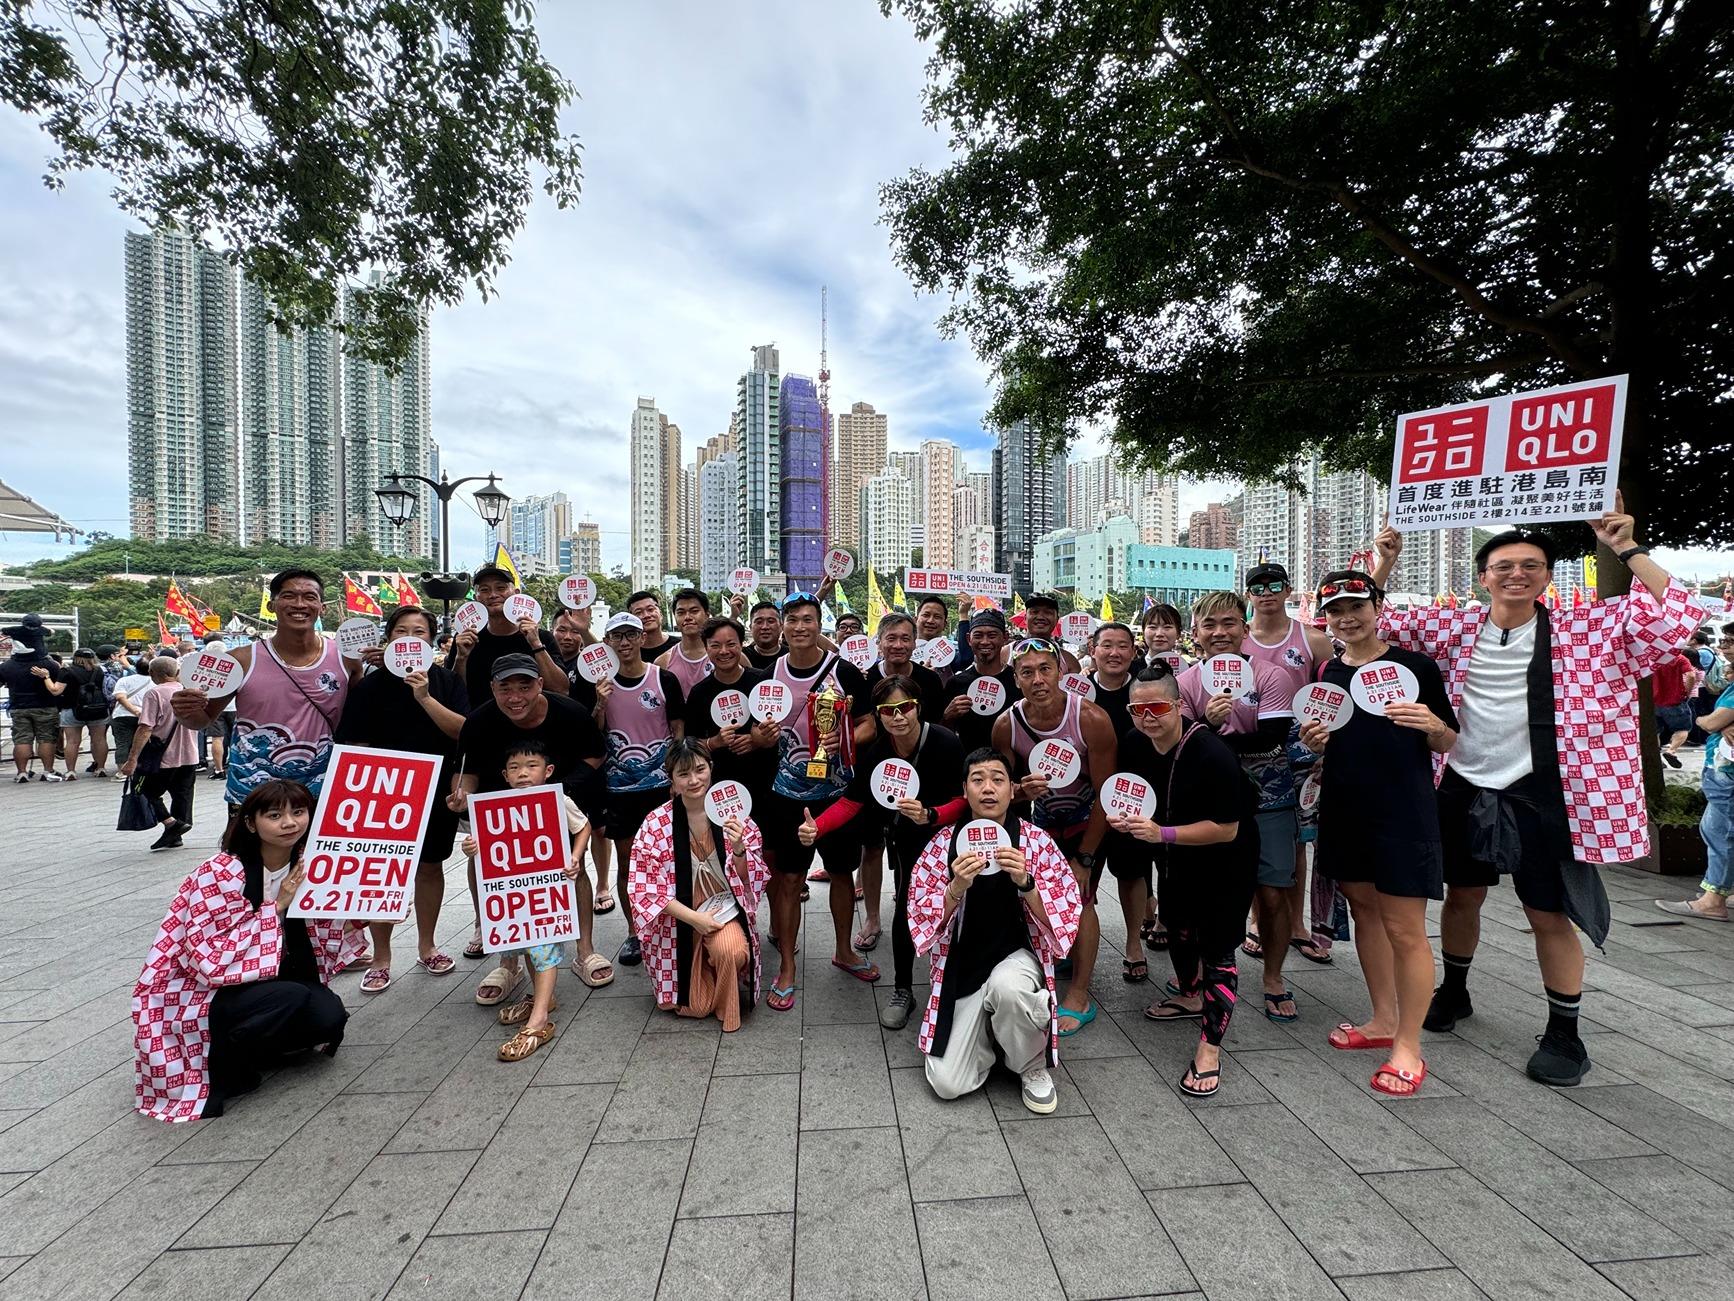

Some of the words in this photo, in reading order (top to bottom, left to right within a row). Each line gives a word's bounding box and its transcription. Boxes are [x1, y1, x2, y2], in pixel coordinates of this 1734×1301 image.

[1521, 398, 1593, 431] UNI
[1518, 429, 1596, 464] QLO
[1398, 466, 1607, 503] 首度進駐港島南
[1396, 502, 1447, 515] LifeWear
[1451, 496, 1504, 510] 伴隨社區
[1511, 489, 1604, 505] 凝聚美好生活
[1395, 516, 1413, 524] THE
[1418, 512, 1476, 523] SOUTHSIDE
[1482, 502, 1603, 519] 2樓214至221號舖
[829, 564, 846, 573] OPEN
[967, 575, 1007, 584] SOUTHSIDE
[590, 662, 613, 676] OPEN
[191, 674, 226, 688] OPEN
[974, 696, 996, 707] OPEN
[1368, 689, 1406, 704] OPEN
[721, 711, 744, 721] OPEN
[1304, 706, 1336, 722] OPEN
[1038, 762, 1065, 779] OPEN
[345, 764, 415, 796] UNI
[880, 784, 906, 798] OPEN
[335, 799, 412, 832] QLO
[718, 803, 744, 818] OPEN
[1111, 800, 1141, 816] OPEN
[485, 803, 544, 835] UNI
[316, 840, 341, 851] THE
[346, 842, 415, 855] SOUTHSIDE
[489, 835, 553, 871] QLO
[307, 855, 412, 887] OPEN
[484, 882, 504, 892] THE
[509, 872, 567, 889] SOUTHSIDE
[299, 890, 354, 912] 6.21
[386, 890, 404, 899] FRI
[357, 900, 373, 912] 11
[377, 900, 402, 912] AM
[486, 884, 570, 922] OPEN
[557, 915, 572, 924] FRI
[489, 922, 531, 946] 6.21
[535, 926, 547, 939] 11
[553, 923, 573, 936] AM
